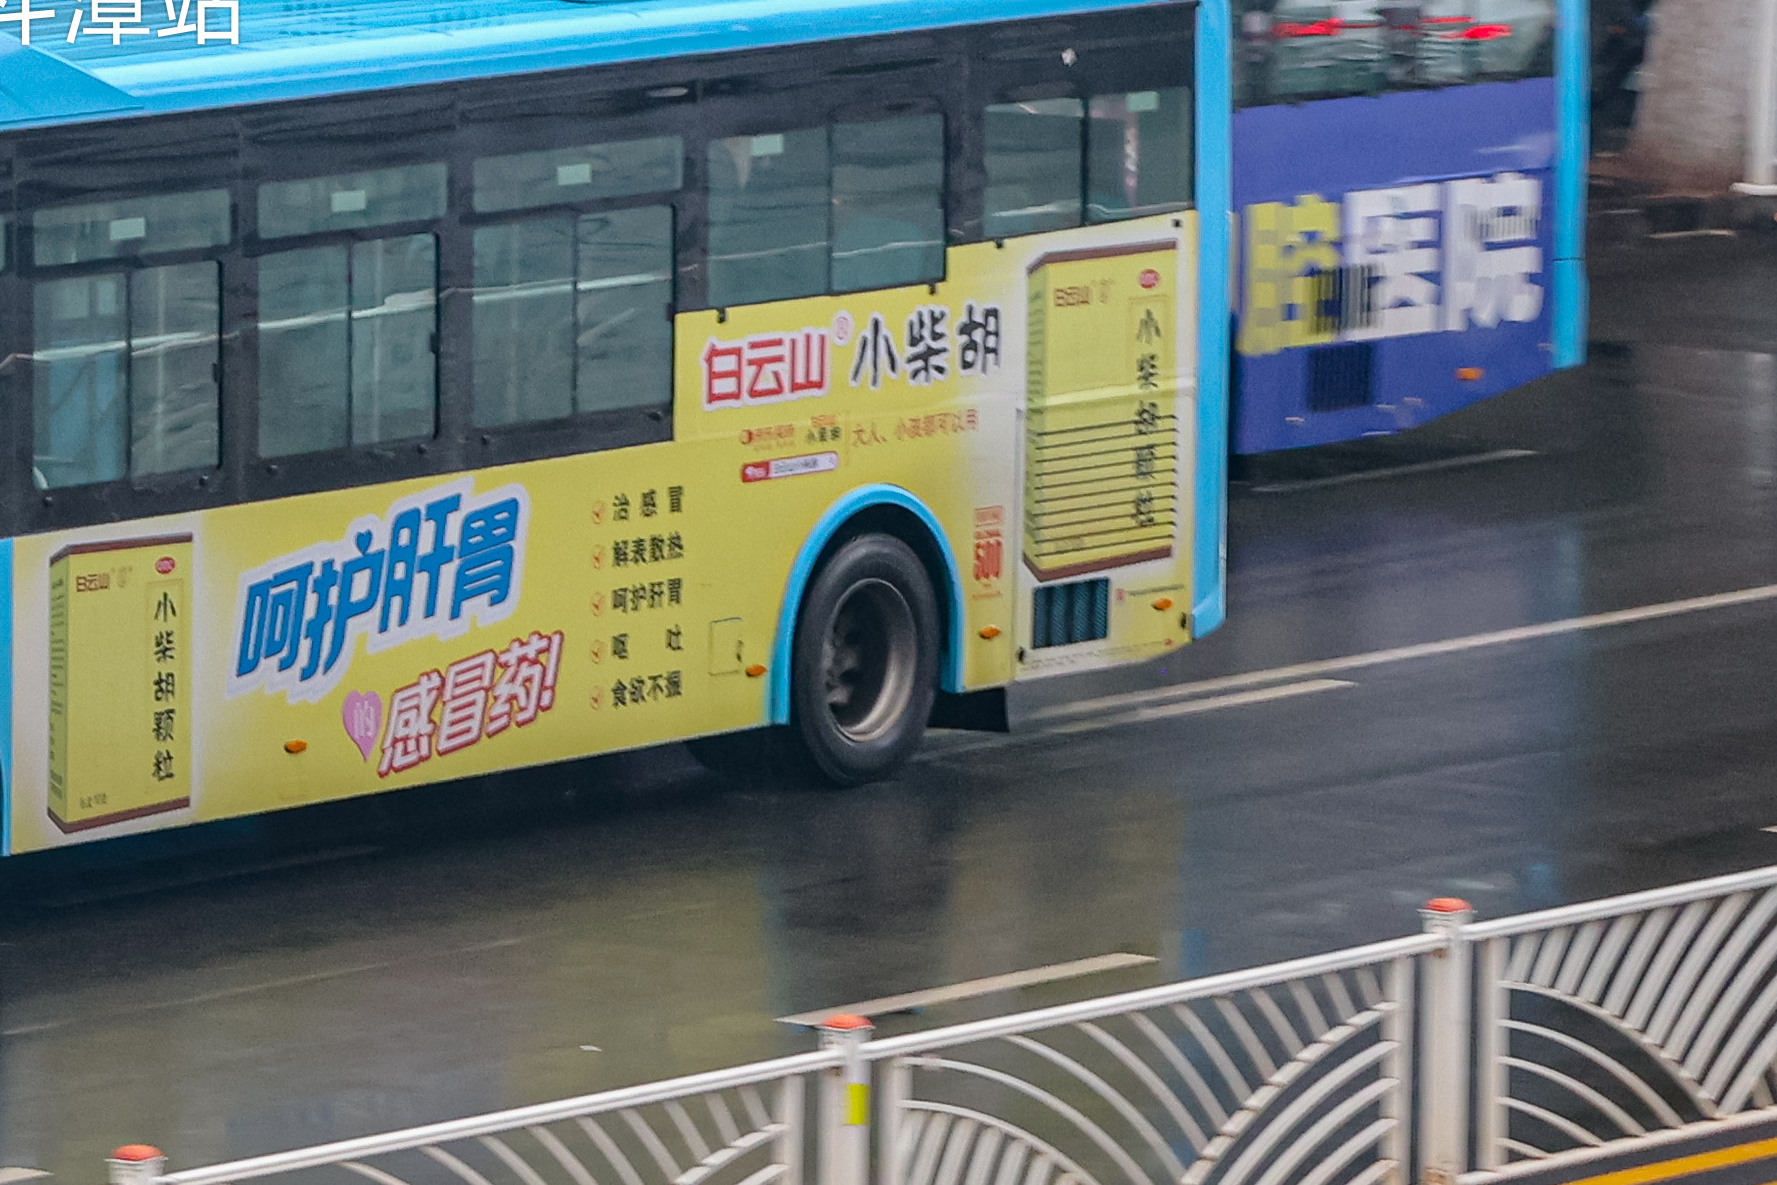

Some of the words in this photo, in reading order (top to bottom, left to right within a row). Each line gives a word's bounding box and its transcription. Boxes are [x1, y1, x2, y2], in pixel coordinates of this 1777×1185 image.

[1230, 173, 1544, 357] 腔医院
[705, 331, 827, 405] 白云山
[850, 301, 1001, 389] 小柴胡
[236, 492, 520, 683] 呵护肝胃
[610, 530, 685, 570] 解表散热
[610, 575, 685, 615] 呵护肝胃
[152, 592, 178, 783] 小柴胡颗粒
[610, 668, 685, 710] 食欲不振
